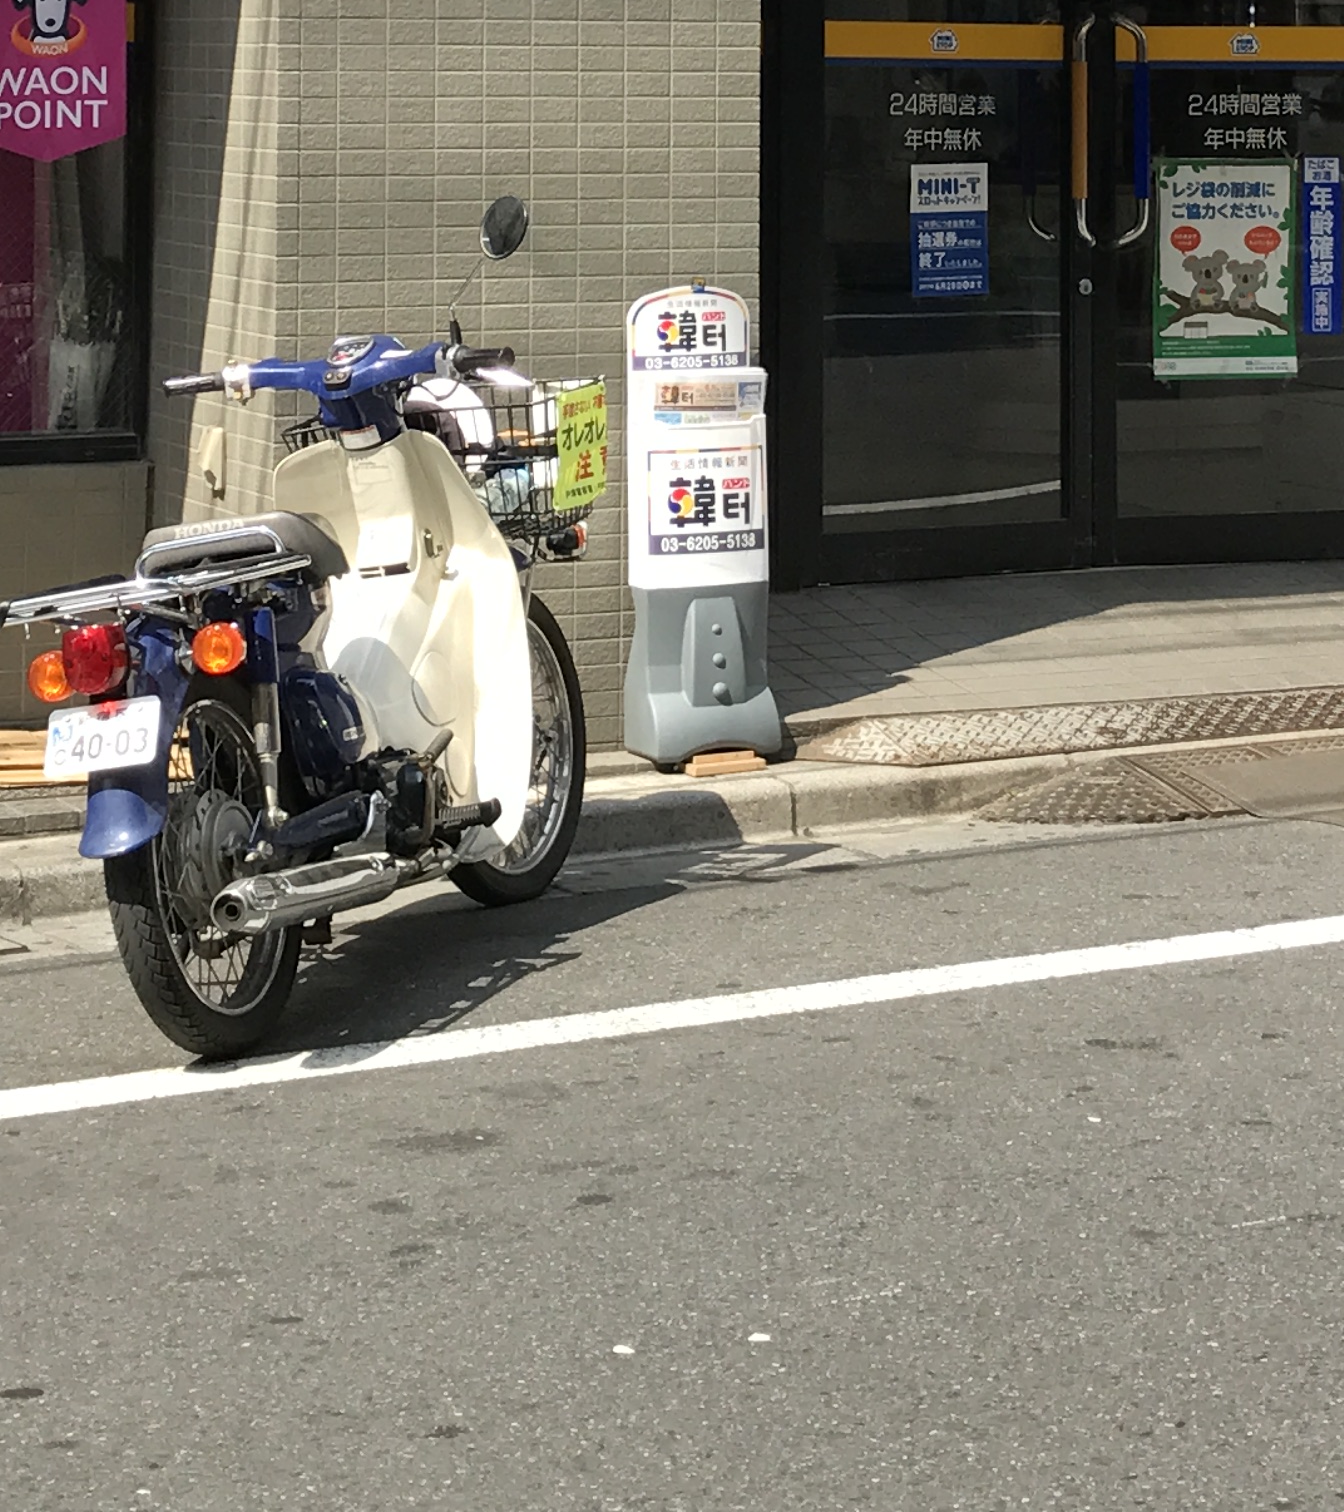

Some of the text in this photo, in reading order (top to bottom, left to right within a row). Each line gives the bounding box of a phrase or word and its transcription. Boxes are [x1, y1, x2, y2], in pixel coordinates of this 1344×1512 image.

[31, 42, 69, 56] WAON
[889, 92, 996, 117] 24時間営業
[1188, 92, 1303, 117] 24時間営業
[904, 126, 982, 151] 年中無休
[1203, 126, 1288, 151] 年中無休
[1172, 181, 1276, 199] レジ袋の削減に
[1309, 185, 1335, 286] 年齢確認
[645, 354, 739, 369] 03-6205-5138
[174, 518, 244, 539] HONDA
[71, 727, 149, 763] 40-03
